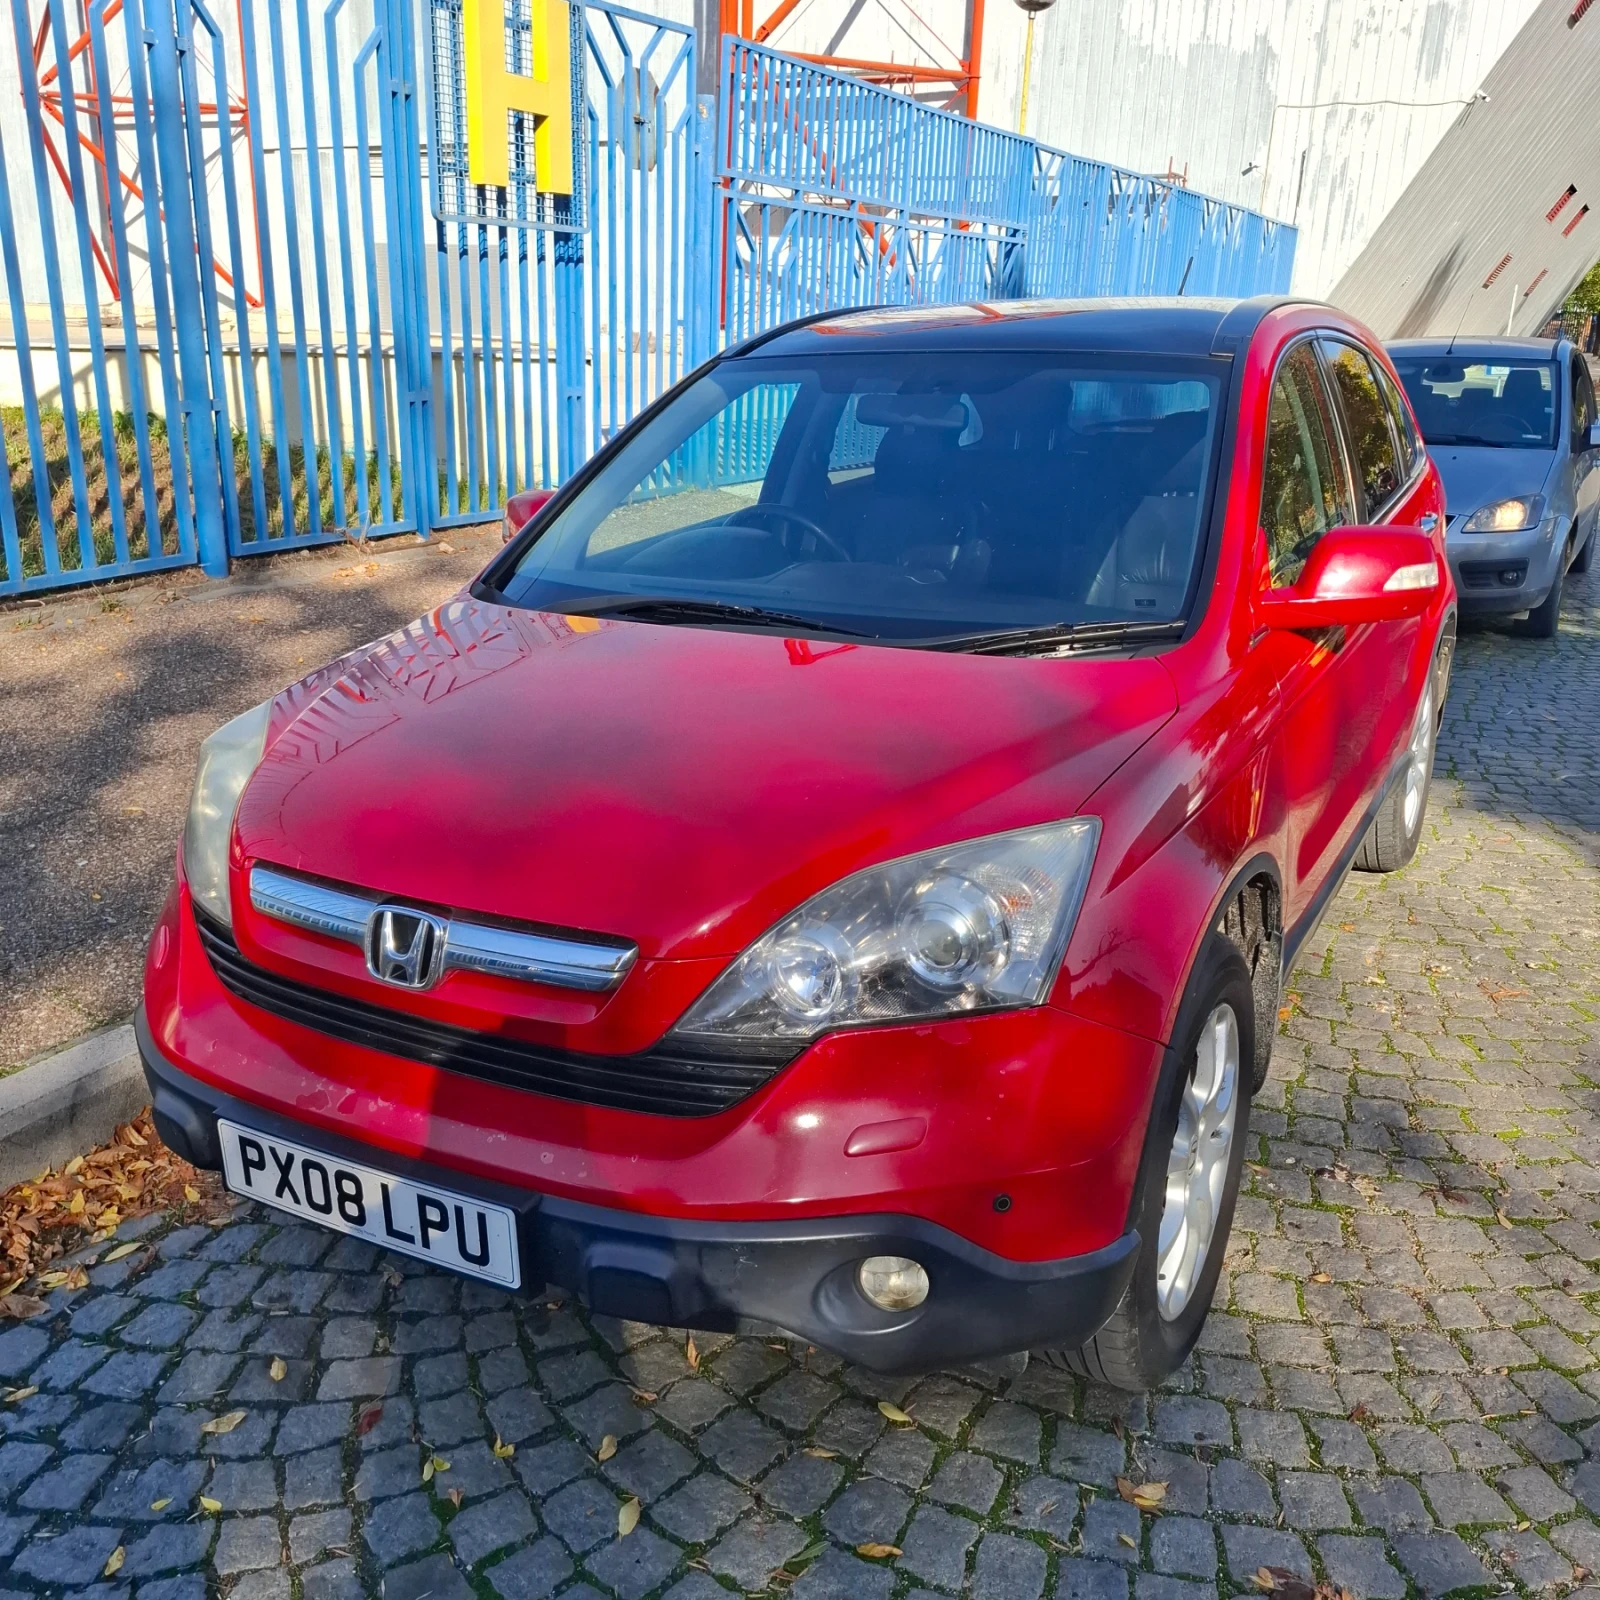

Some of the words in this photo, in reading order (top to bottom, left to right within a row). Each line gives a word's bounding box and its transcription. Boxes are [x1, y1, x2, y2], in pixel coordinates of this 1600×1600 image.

[462, 0, 573, 195] H
[238, 1134, 367, 1227] PX08
[380, 1182, 490, 1267] LPU
